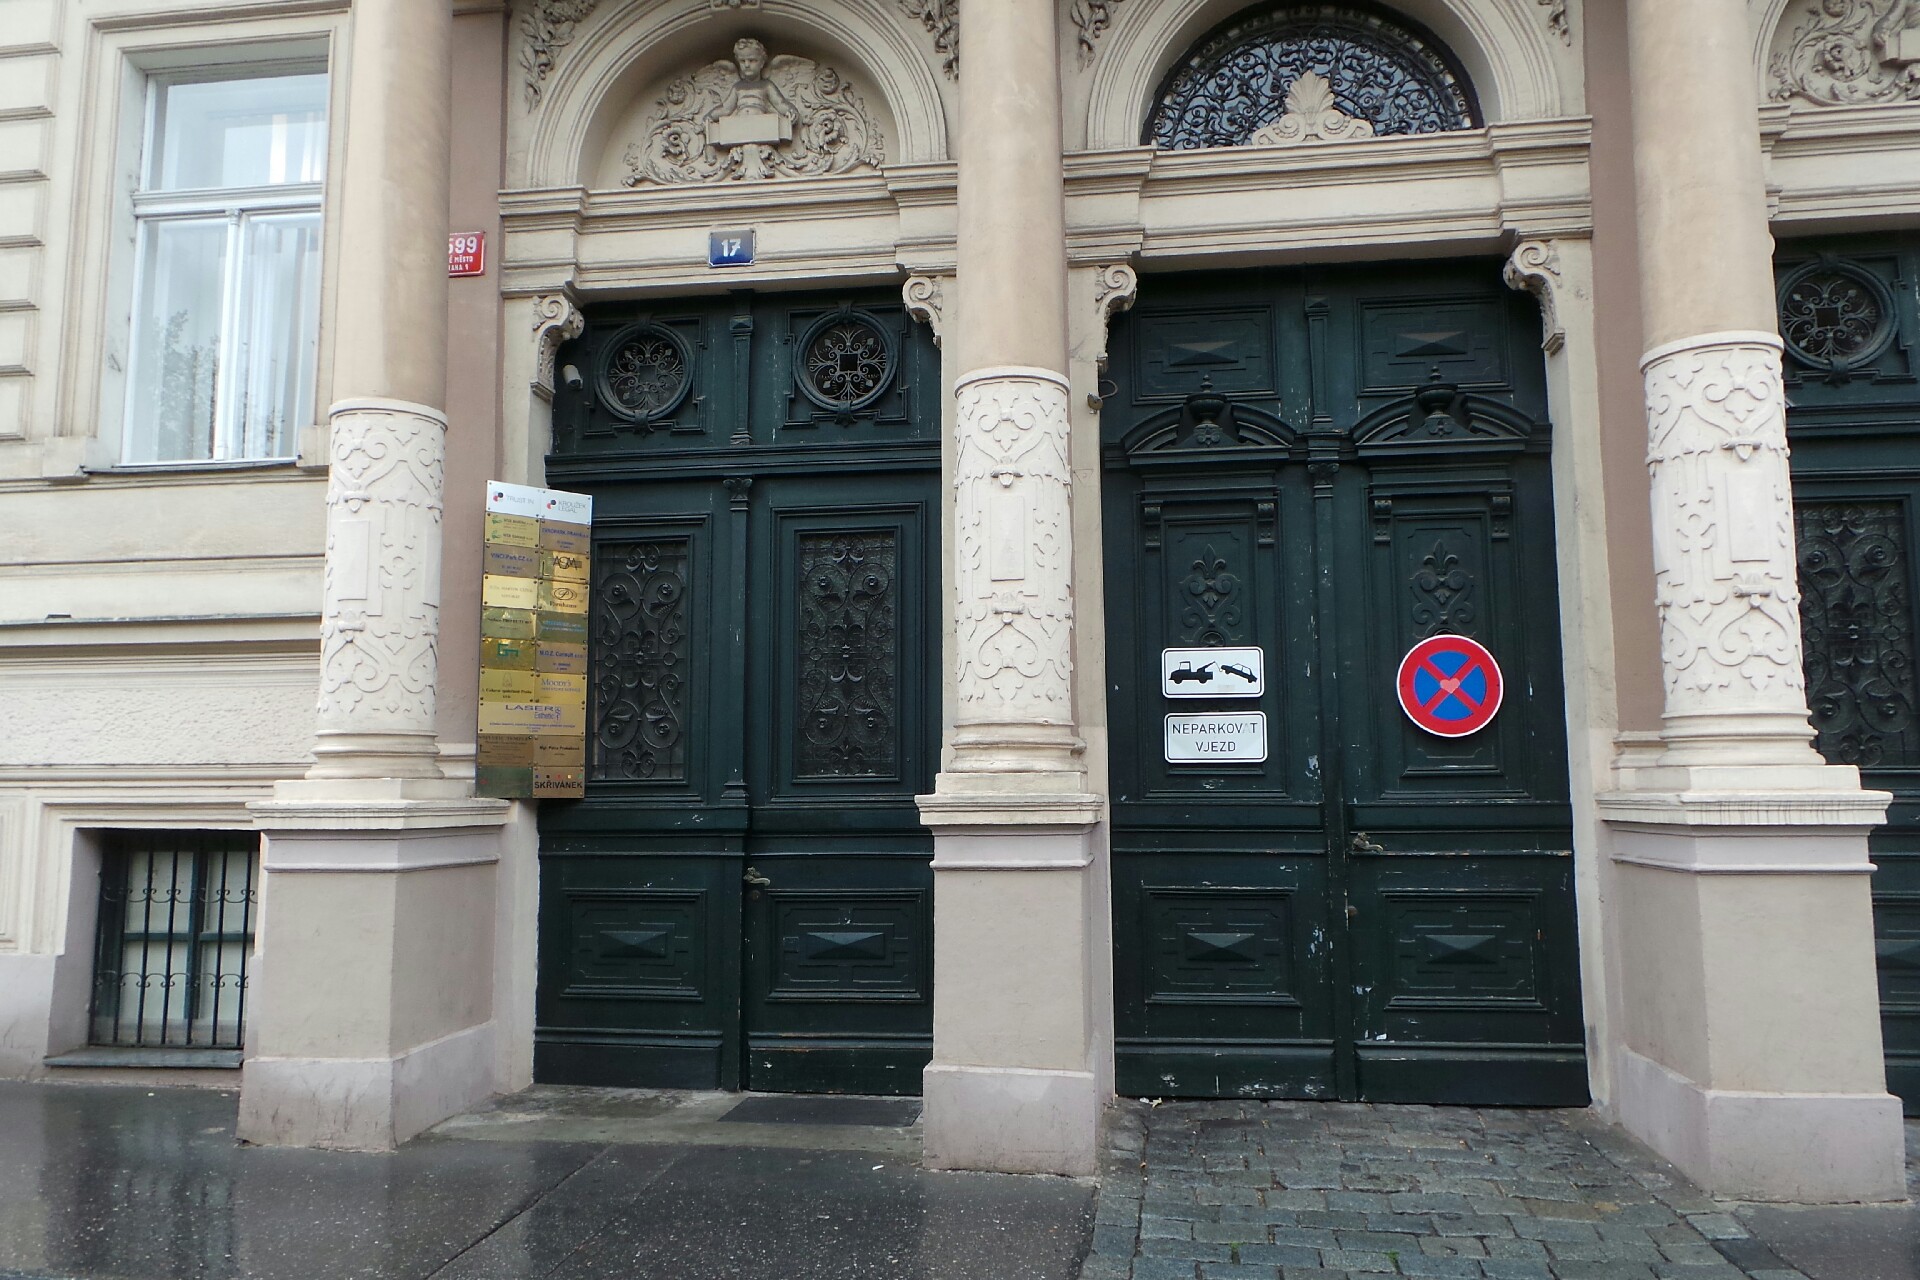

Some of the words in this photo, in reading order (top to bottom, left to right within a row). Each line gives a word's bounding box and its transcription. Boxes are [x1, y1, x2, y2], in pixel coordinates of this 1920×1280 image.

[721, 238, 741, 257] 17
[1195, 741, 1236, 753] VJEZD
[534, 779, 583, 788] SKŘIVÁNEK
